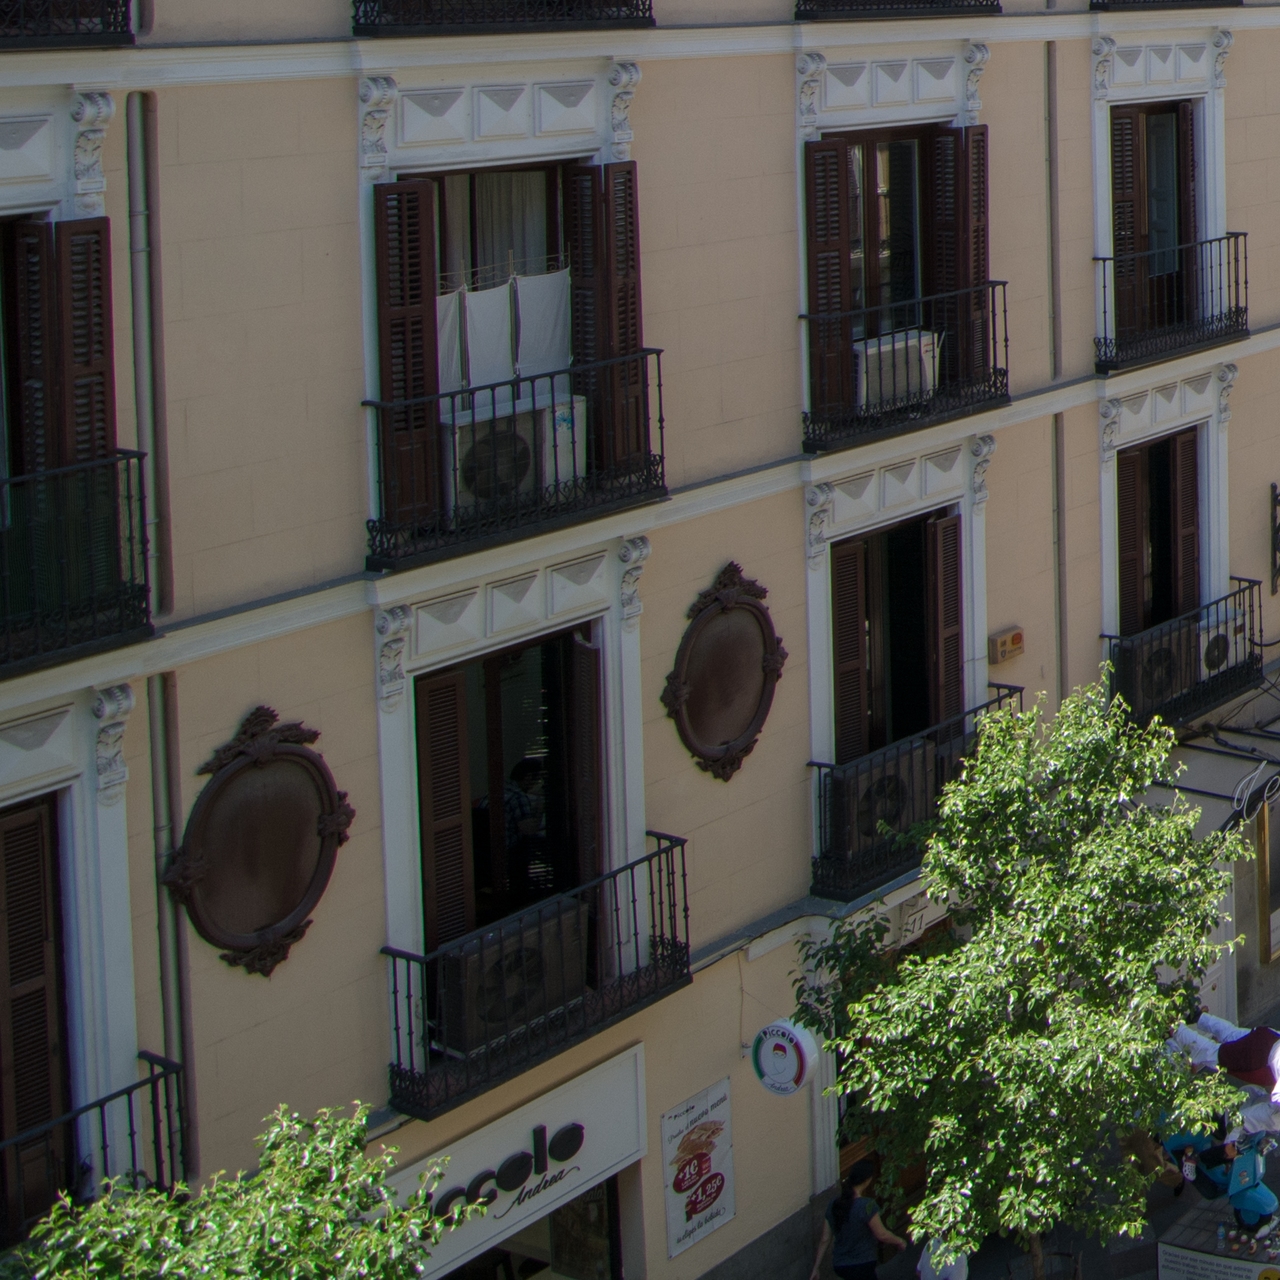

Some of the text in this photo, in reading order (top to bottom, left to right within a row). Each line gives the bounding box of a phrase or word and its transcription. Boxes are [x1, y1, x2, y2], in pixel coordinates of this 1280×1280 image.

[761, 1026, 797, 1045] Piccolo
[399, 1122, 585, 1241] ccolo
[493, 1165, 581, 1219] Andrea
